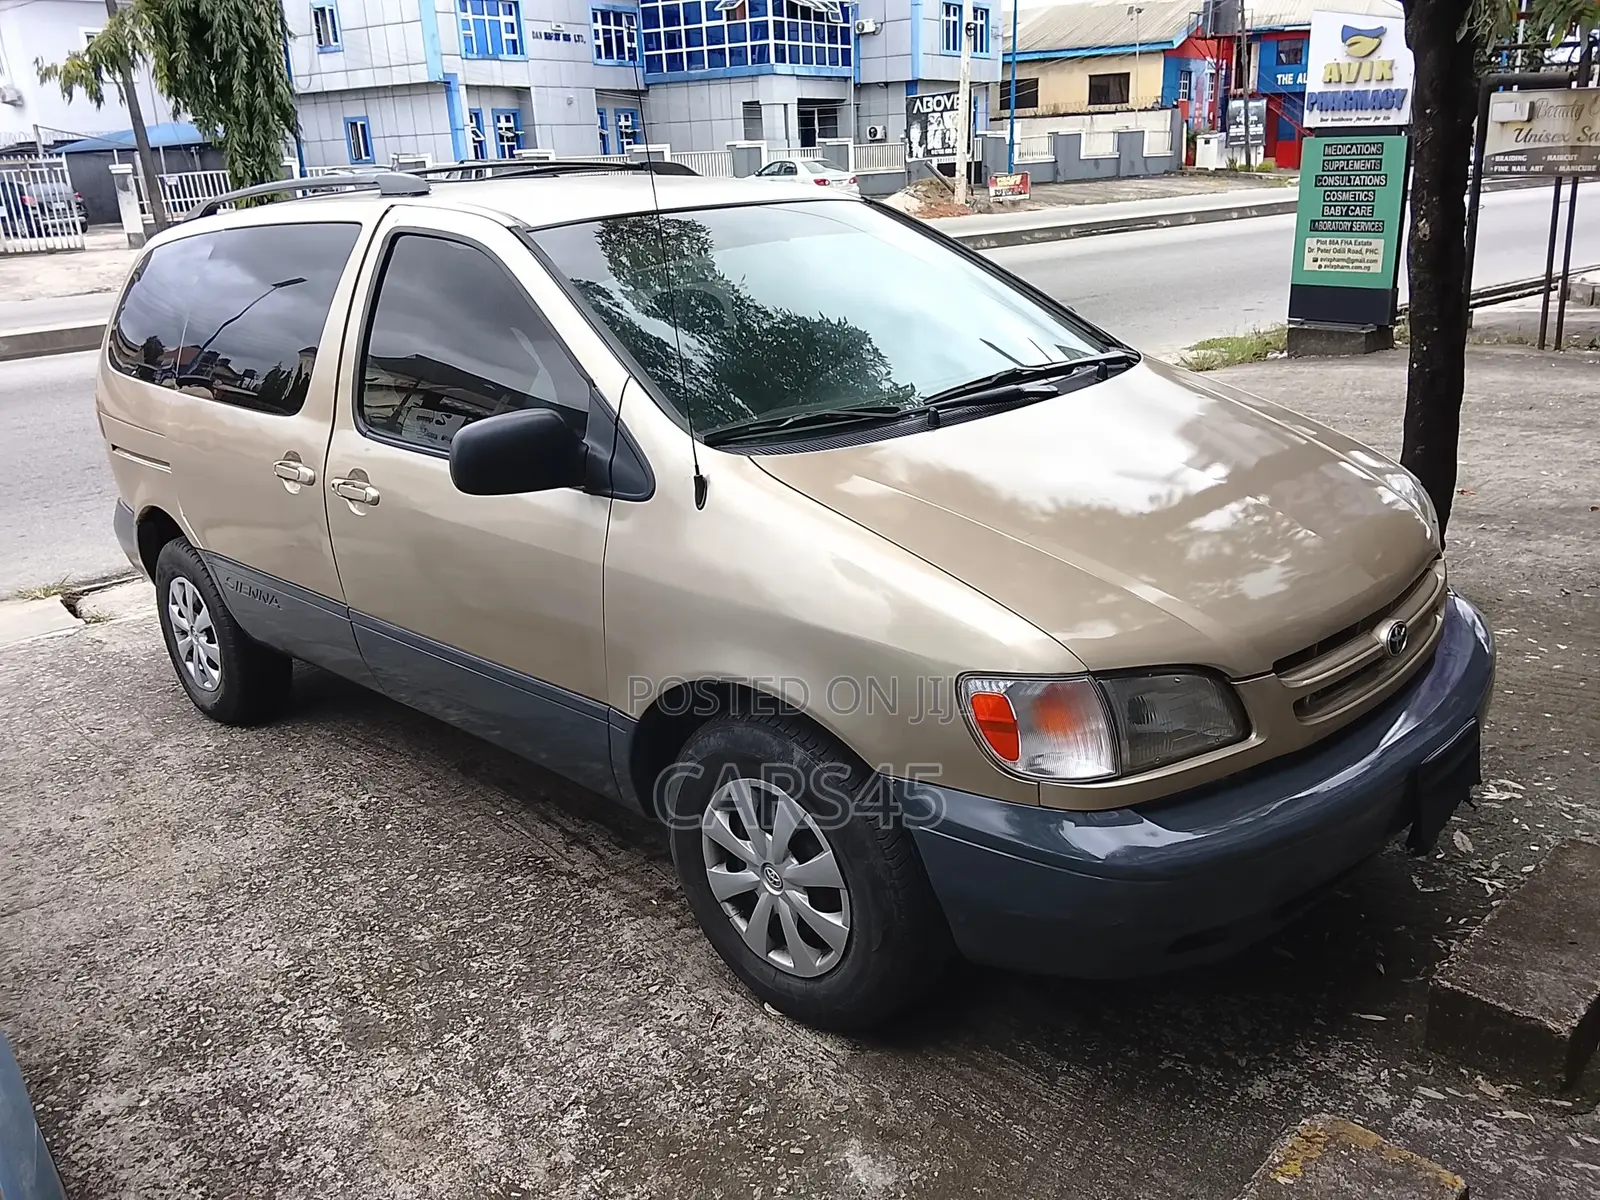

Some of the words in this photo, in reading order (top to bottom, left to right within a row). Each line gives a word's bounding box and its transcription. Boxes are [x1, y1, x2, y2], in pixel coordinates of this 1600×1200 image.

[1275, 73, 1294, 86] THE
[912, 93, 960, 114] ABOVE
[1306, 88, 1408, 112] PHARMACY
[1536, 97, 1585, 121] Beauty
[1514, 127, 1571, 144] Unisex
[1324, 143, 1383, 156] MEDICATIONS
[1323, 160, 1381, 171] SUPPLEMENTS
[1316, 175, 1387, 186] CONSULTATIONS
[1324, 191, 1375, 202] COSMETICS
[1323, 206, 1347, 216] BABY
[1348, 206, 1373, 217] CARE
[1310, 220, 1351, 231] LABORATORY
[1352, 221, 1384, 232] SERVICES
[224, 576, 283, 611] SIENNA
